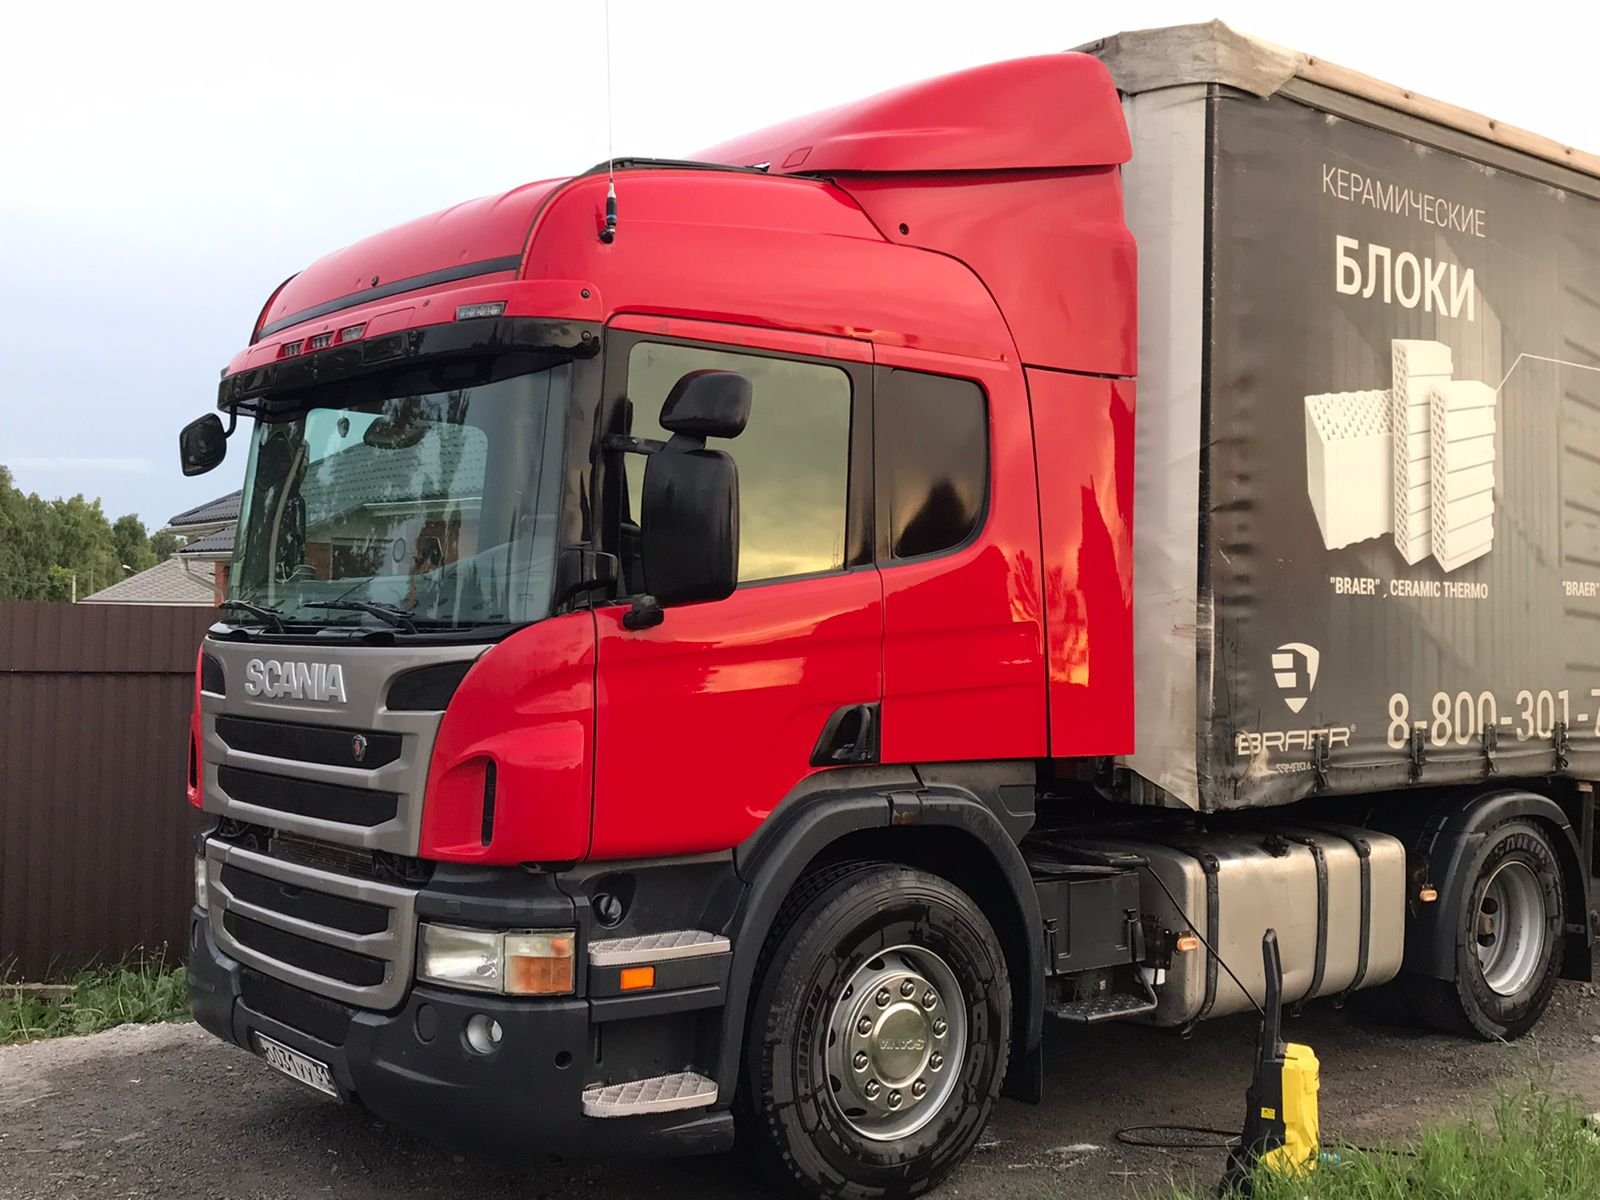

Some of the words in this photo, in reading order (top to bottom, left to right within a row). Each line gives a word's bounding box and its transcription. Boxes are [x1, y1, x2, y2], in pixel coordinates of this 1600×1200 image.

[1322, 163, 1487, 238] КЕРАМИЧЕСКИЕ
[1335, 234, 1476, 322] БЛОКИ
[1389, 579, 1441, 598] CERAMIC
[1442, 581, 1489, 599] THERMO
[244, 658, 347, 703] SCANIA
